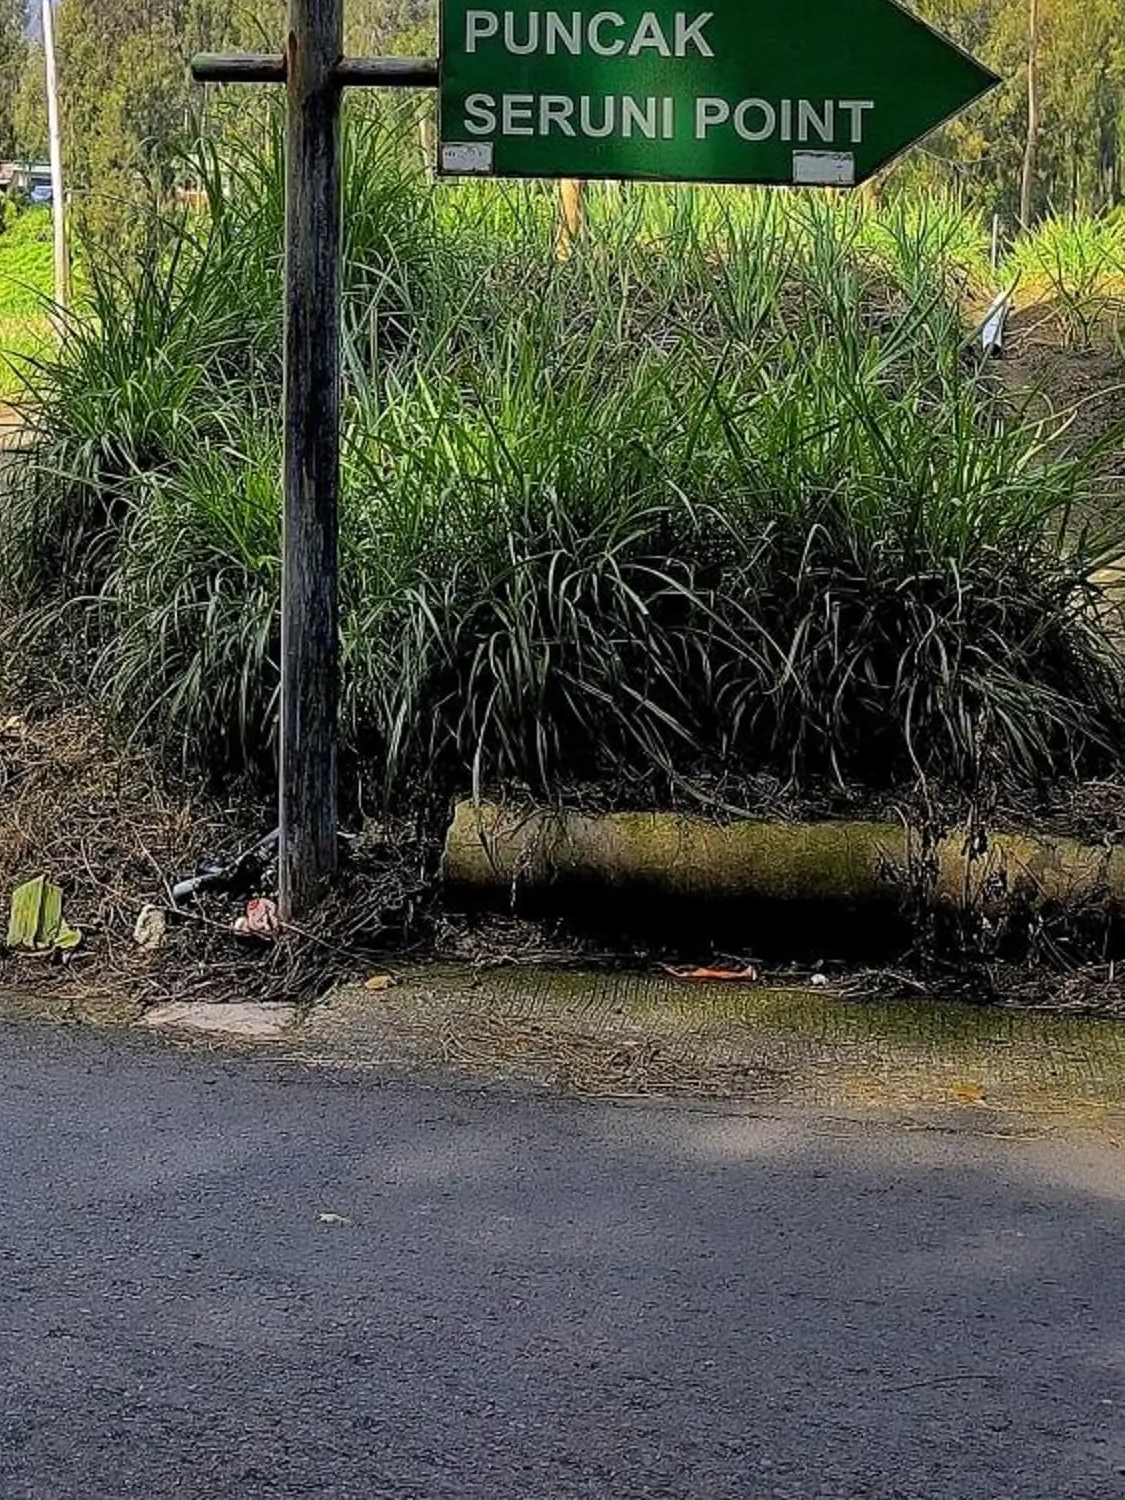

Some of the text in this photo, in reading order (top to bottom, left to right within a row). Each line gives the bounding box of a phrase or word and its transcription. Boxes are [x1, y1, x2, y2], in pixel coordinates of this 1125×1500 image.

[464, 10, 715, 58] PUNCAK
[463, 93, 874, 143] SERUNI POINT
